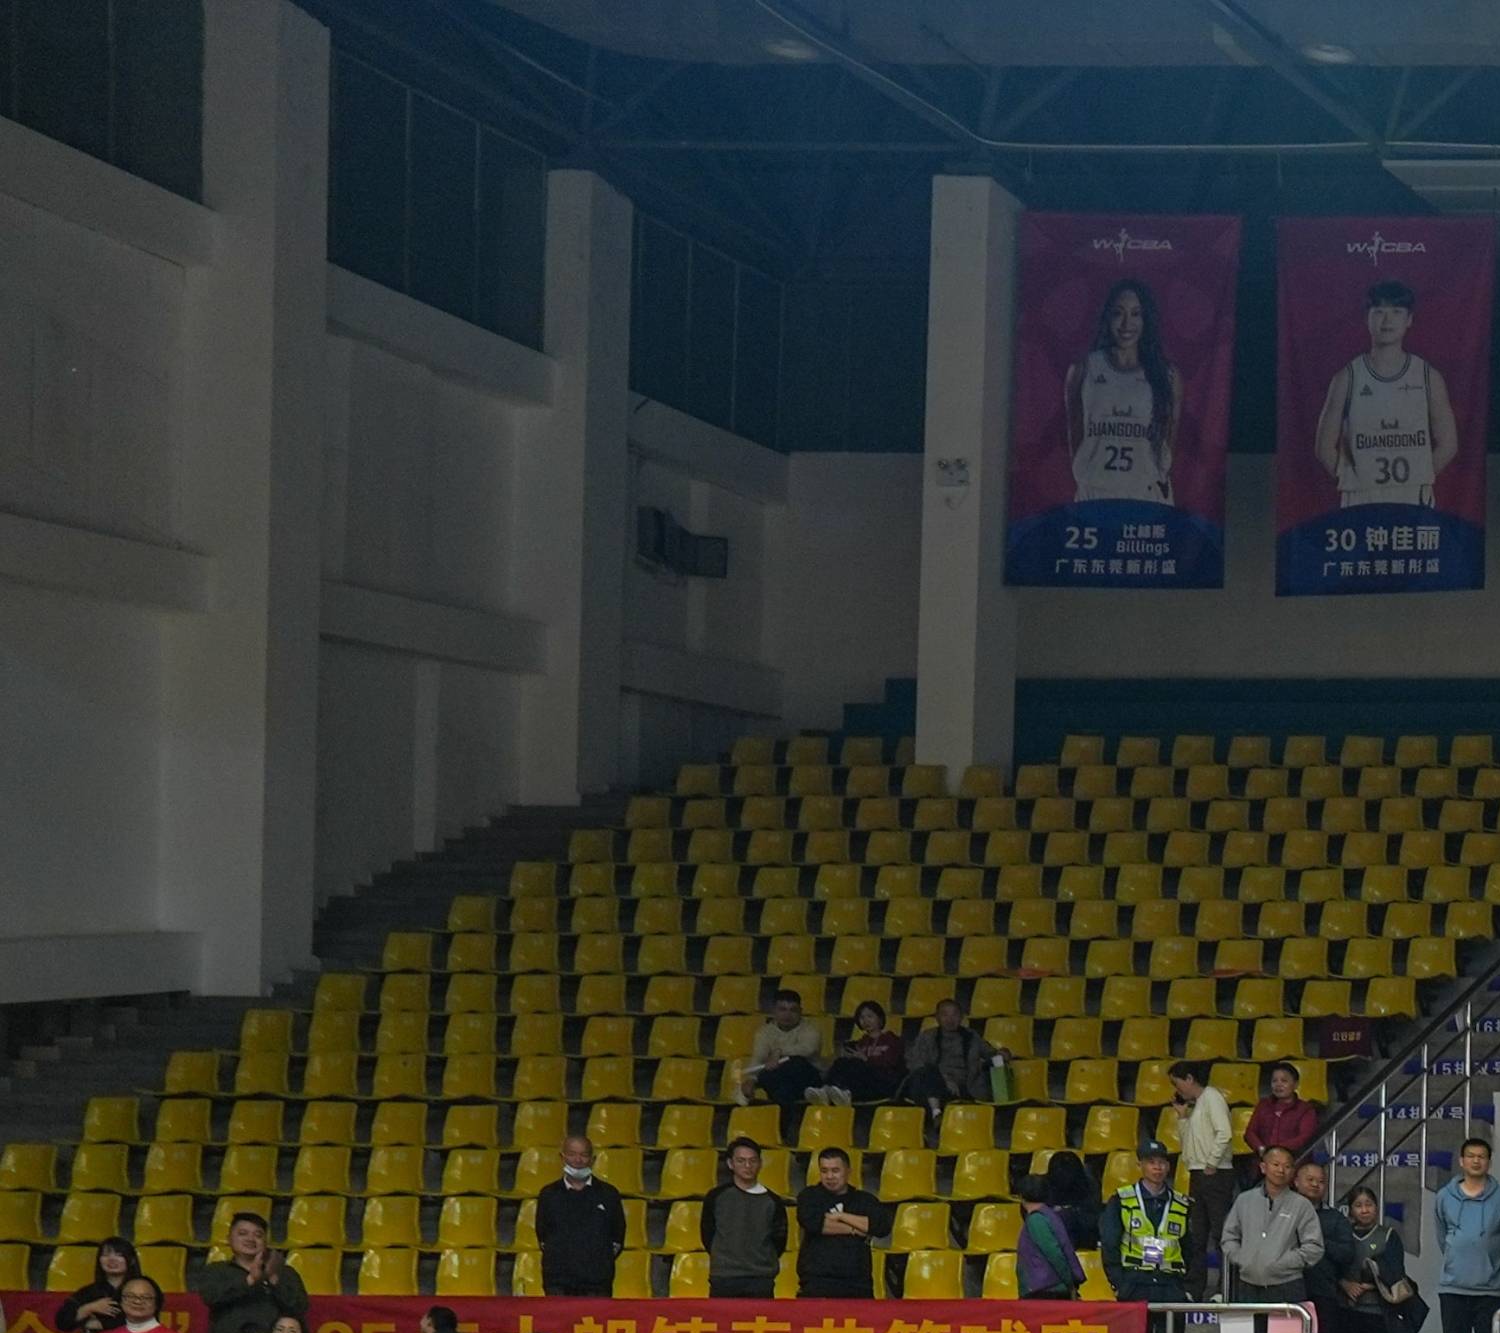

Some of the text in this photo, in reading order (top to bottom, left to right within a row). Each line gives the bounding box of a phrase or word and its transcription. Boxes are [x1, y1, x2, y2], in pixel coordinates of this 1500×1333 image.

[1356, 429, 1426, 451] GUANGDONG
[1105, 445, 1134, 472] 25
[1375, 458, 1411, 485] 30
[1065, 525, 1098, 551] 25
[1116, 541, 1170, 556] Billings
[1325, 525, 1440, 552] 30 钟佳丽
